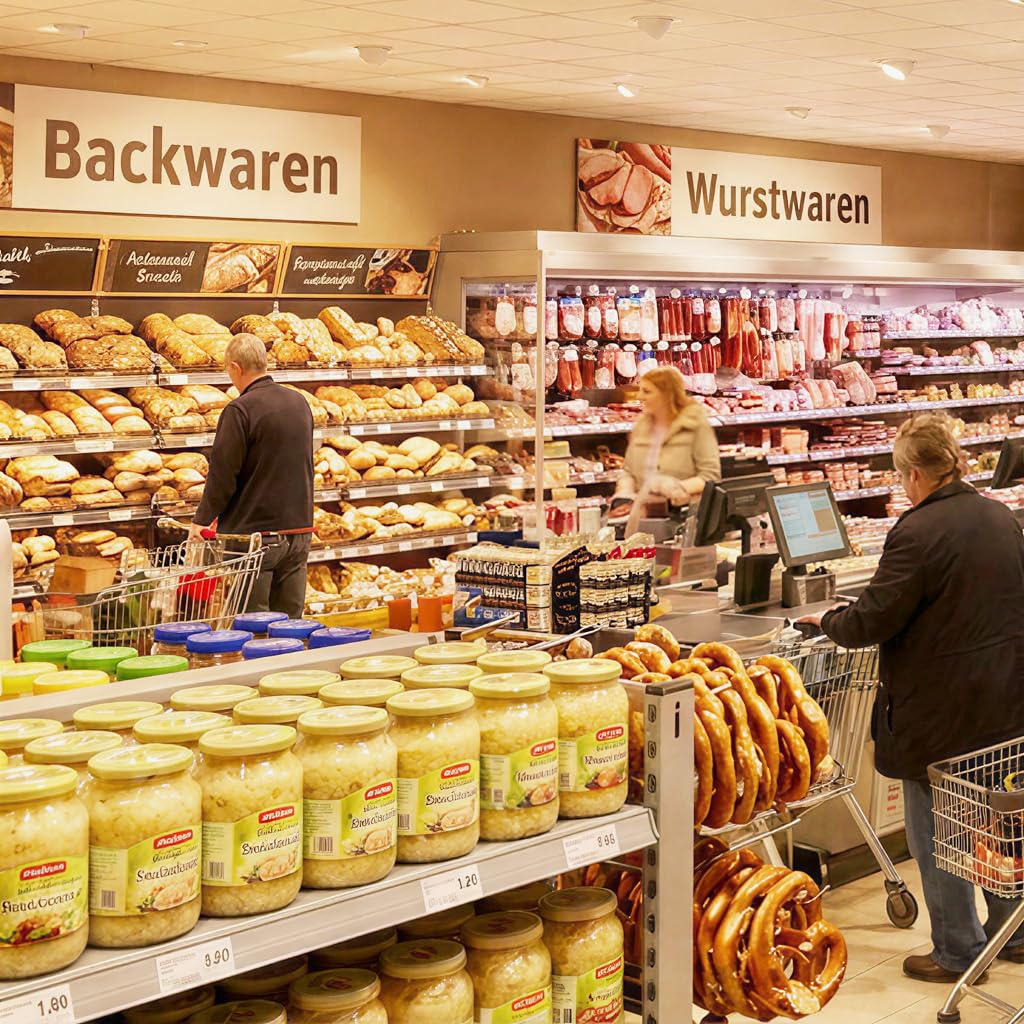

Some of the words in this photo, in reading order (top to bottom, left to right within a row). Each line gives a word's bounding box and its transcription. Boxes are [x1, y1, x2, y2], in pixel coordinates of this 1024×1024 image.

[45, 118, 339, 195] Backwaren
[686, 170, 870, 225] Wurstwaren
[457, 873, 478, 890] 1.20
